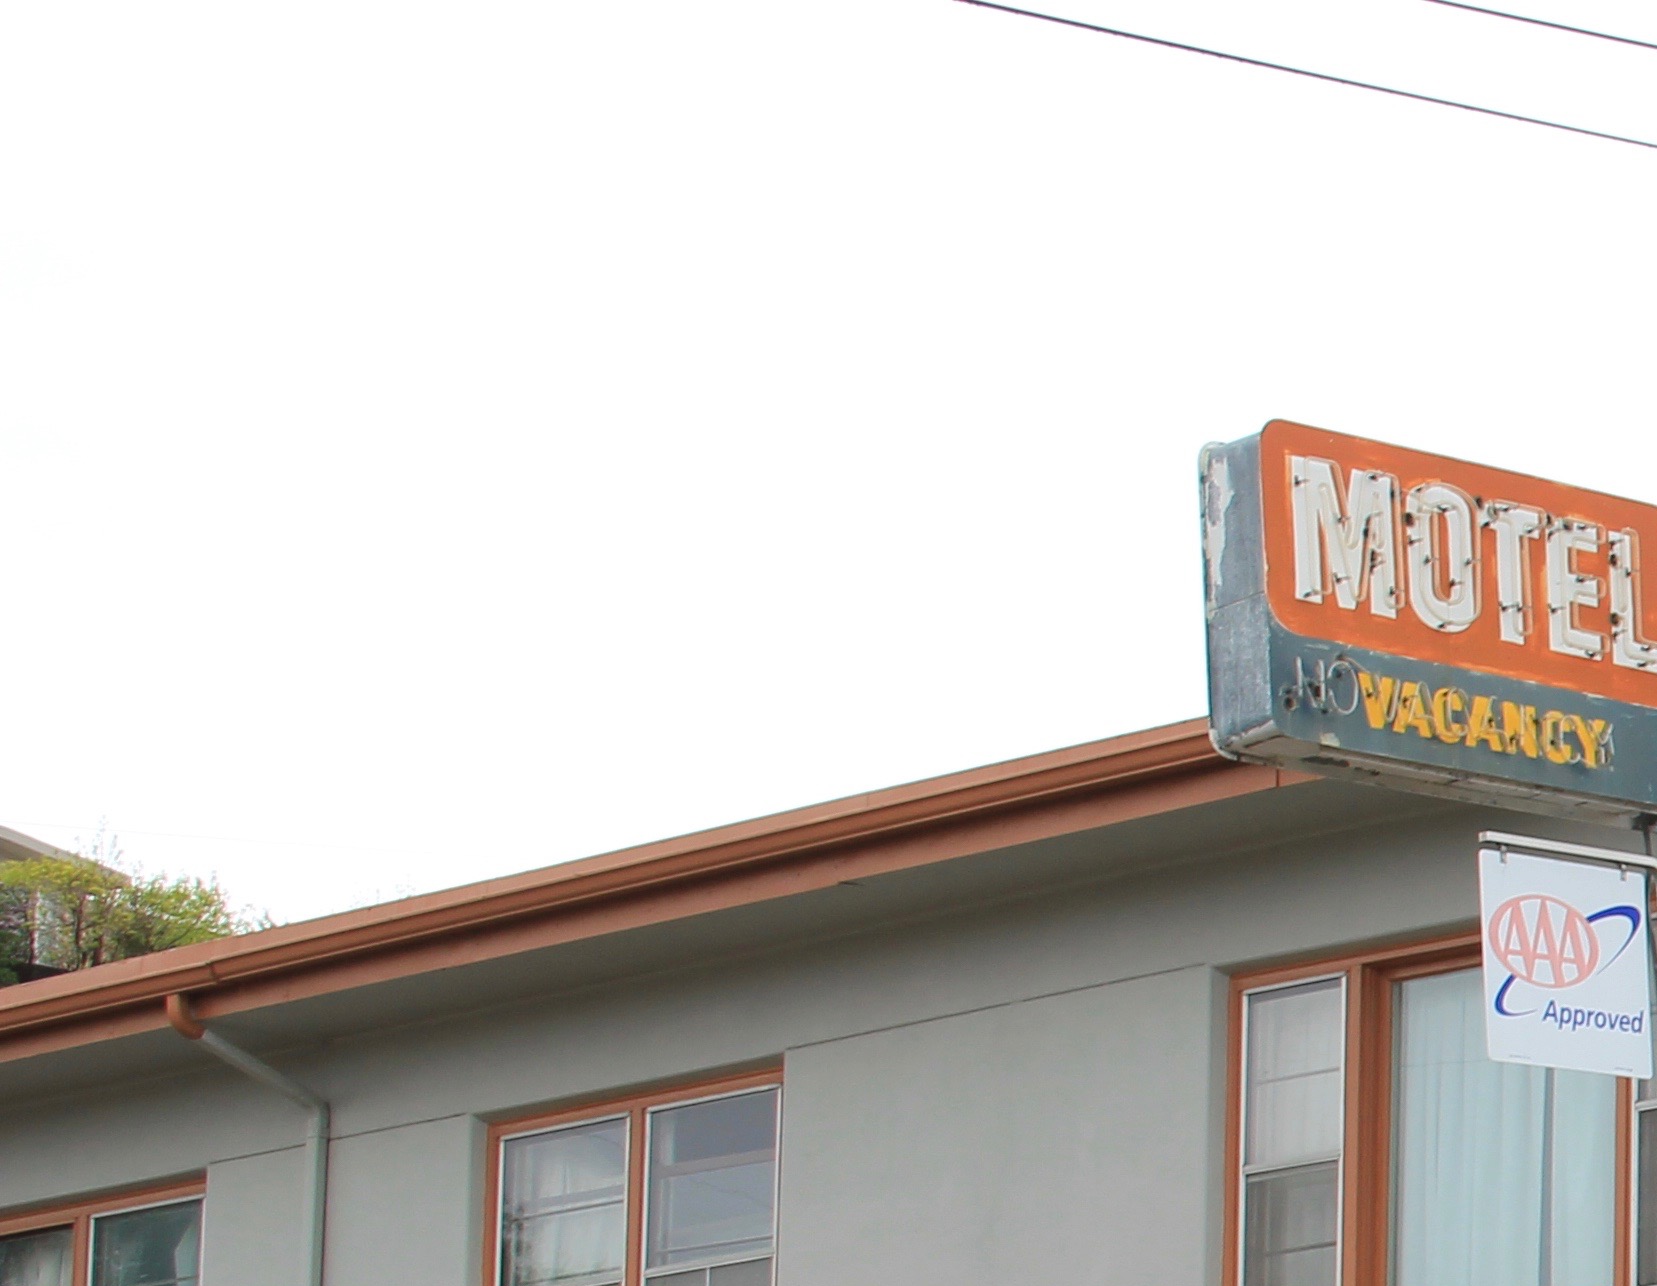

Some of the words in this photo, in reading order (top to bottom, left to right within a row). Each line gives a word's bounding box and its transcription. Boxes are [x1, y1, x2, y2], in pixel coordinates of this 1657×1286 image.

[1294, 655, 1359, 716] NO
[1357, 671, 1614, 769] VACANCY
[1502, 897, 1592, 988] AAA
[1542, 1000, 1645, 1034] Approved
